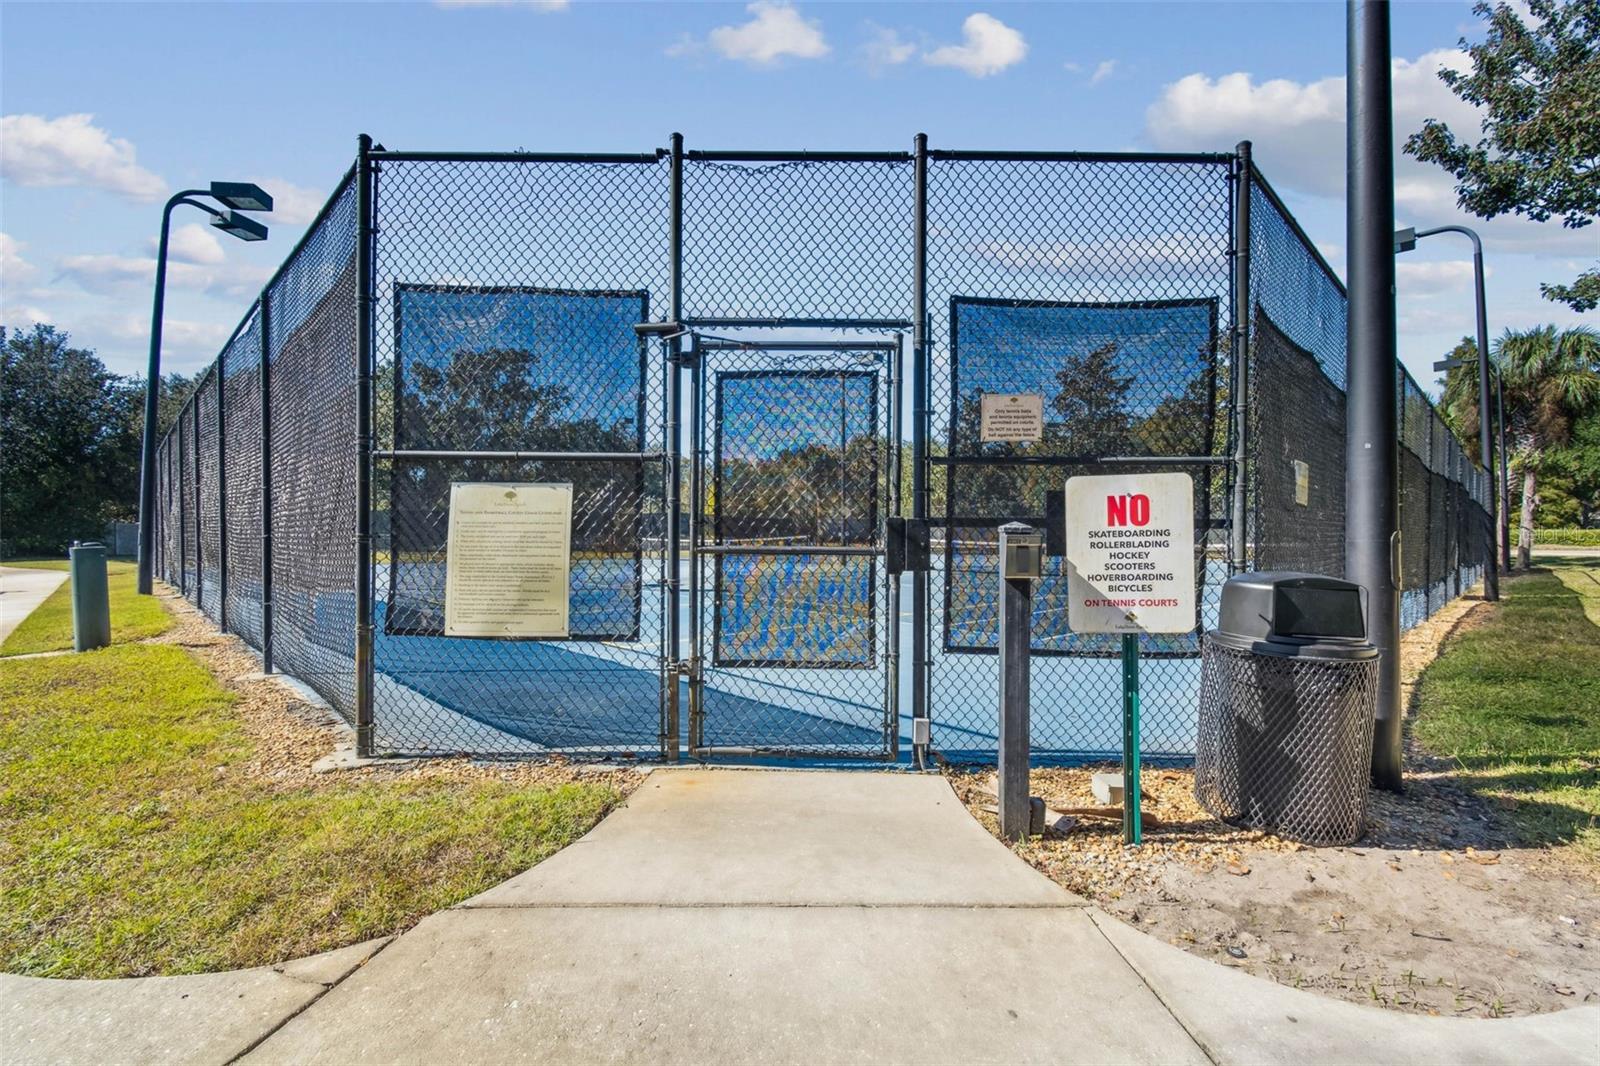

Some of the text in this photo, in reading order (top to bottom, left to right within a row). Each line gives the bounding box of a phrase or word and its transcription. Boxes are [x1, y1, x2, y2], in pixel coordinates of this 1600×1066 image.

[1107, 494, 1150, 527] NO
[1088, 529, 1171, 538] SKATEBOARDING
[1090, 540, 1170, 549] ROLLERBLADING
[1109, 552, 1150, 560] HOCKEY
[1104, 562, 1155, 571] SCOOTERS
[1088, 573, 1174, 582] HOVERBOARDING
[1108, 584, 1153, 592] BICYCLES
[1138, 599, 1178, 607] COURTS
